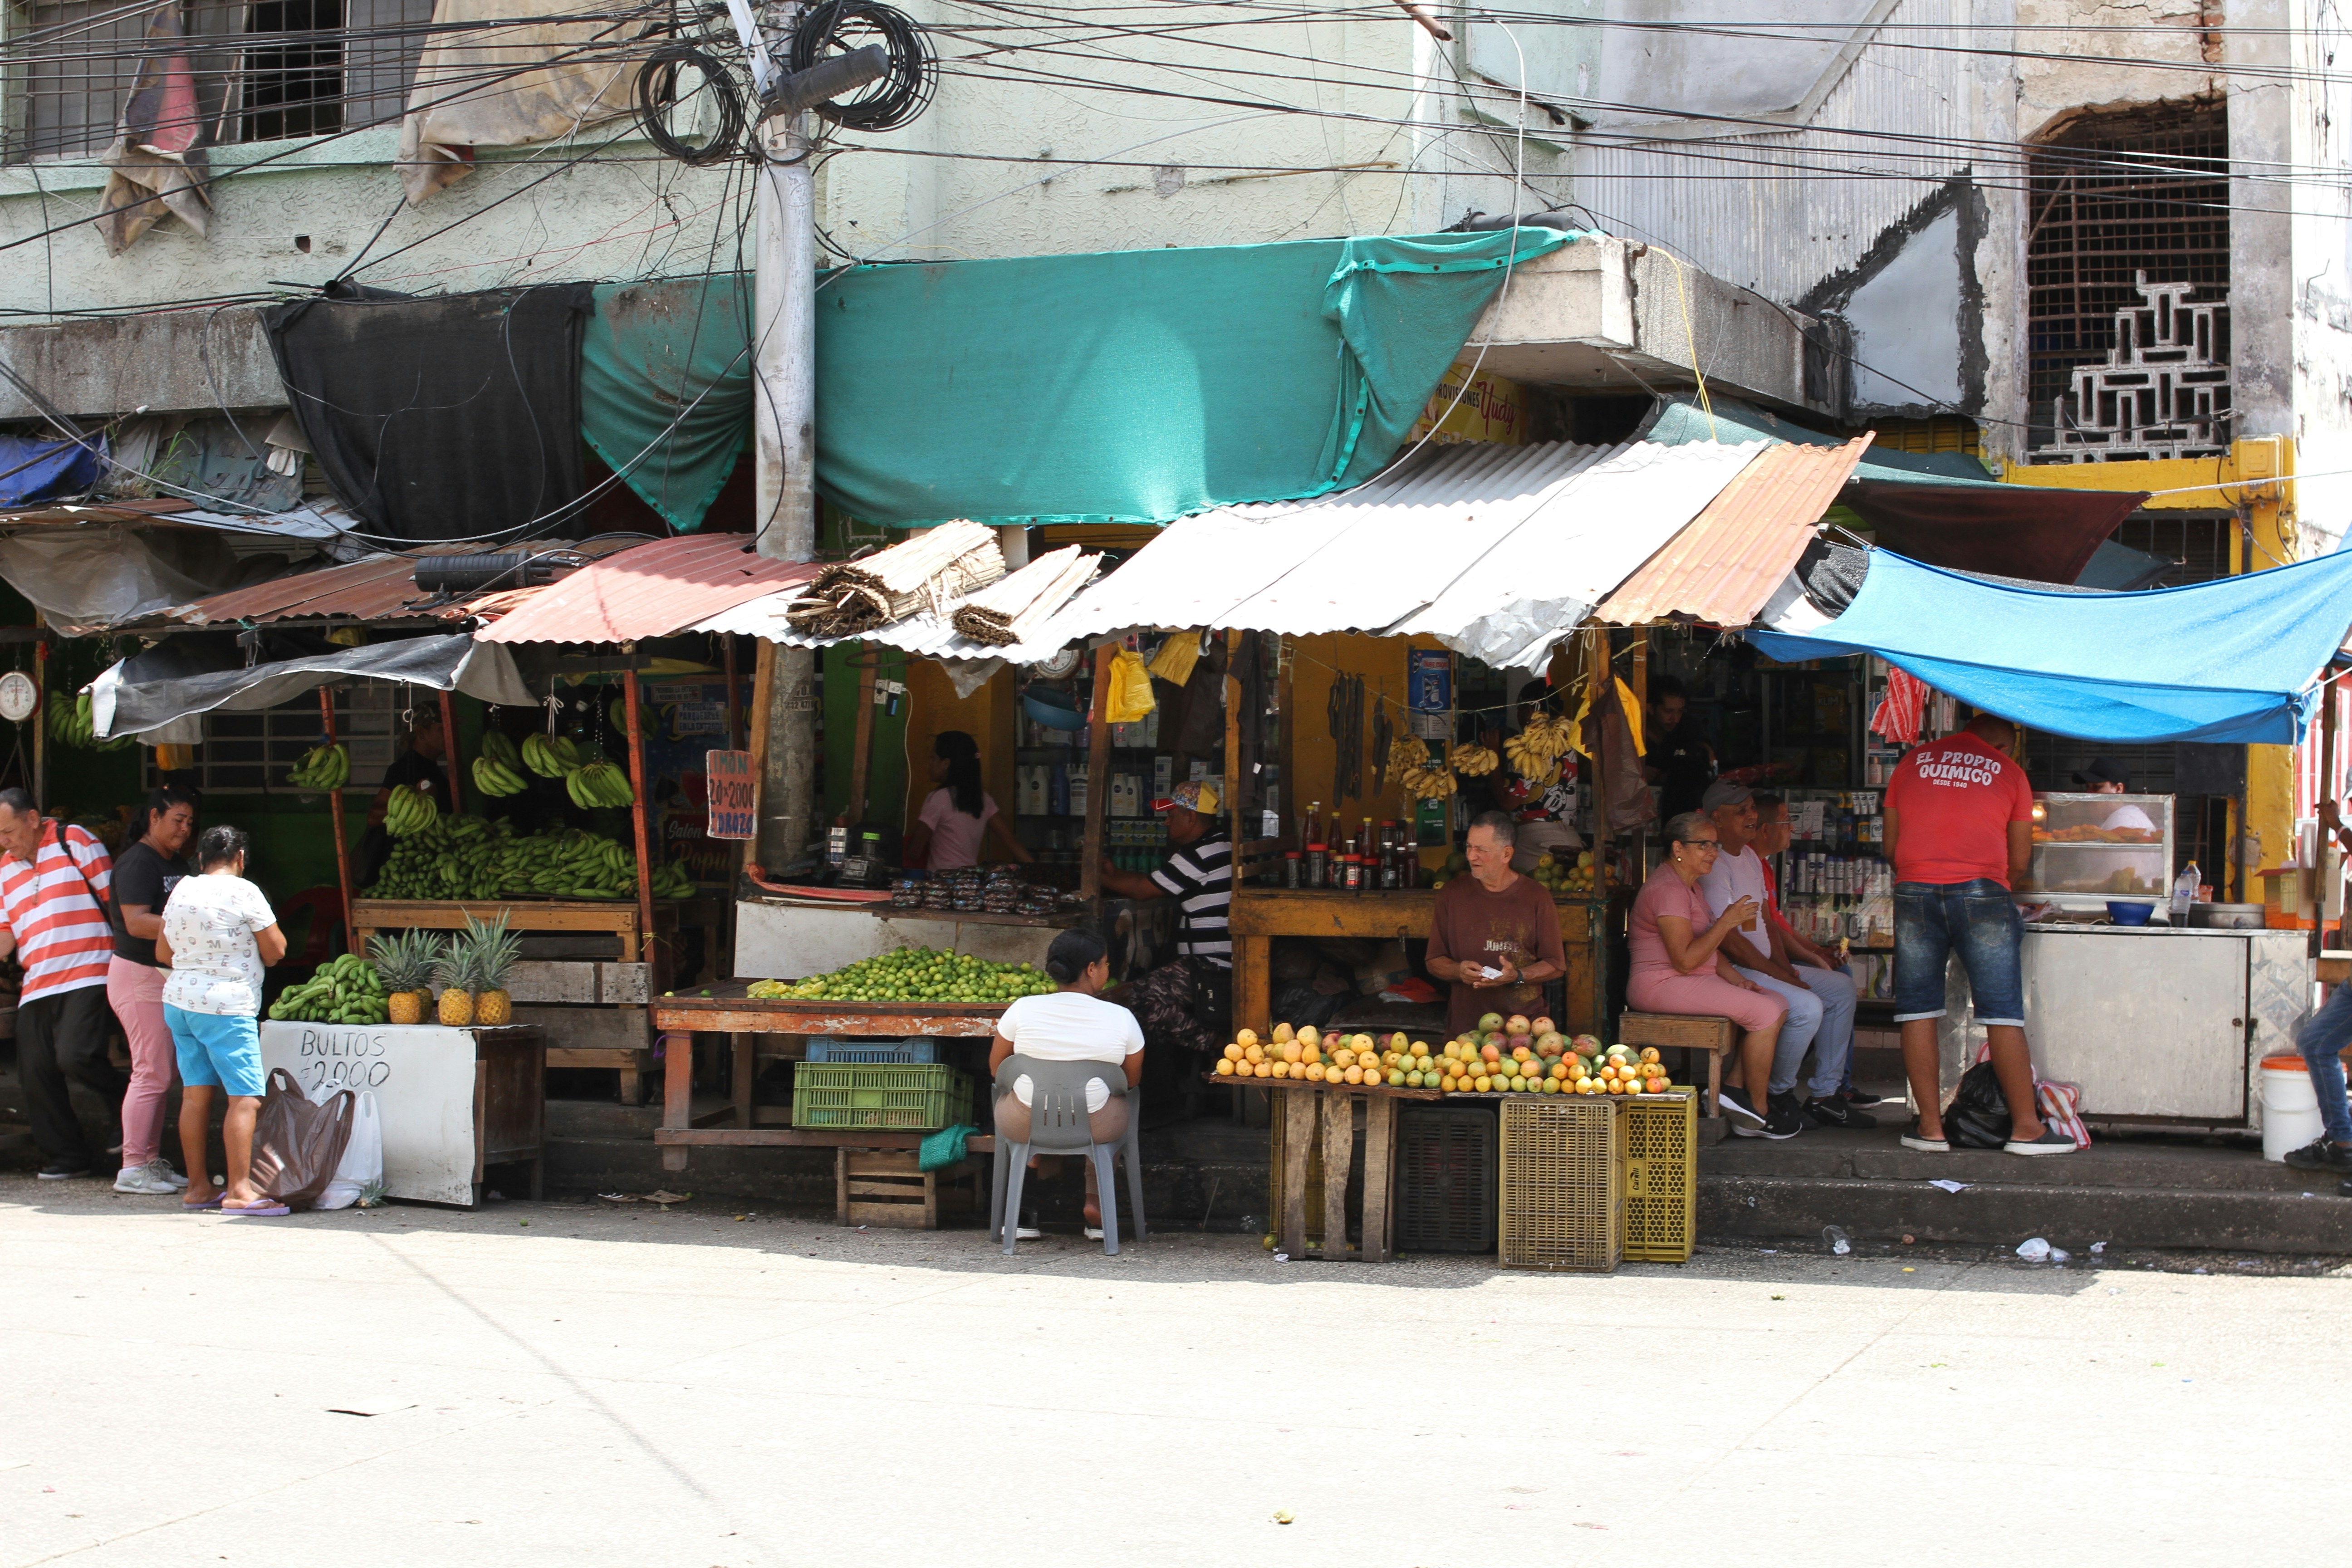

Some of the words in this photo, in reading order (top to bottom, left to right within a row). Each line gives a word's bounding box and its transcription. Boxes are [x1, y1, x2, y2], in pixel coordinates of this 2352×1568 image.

[1476, 380, 1516, 436] Yudy
[1916, 751, 1934, 765] EL
[1940, 751, 2001, 774] PROPIO
[1919, 764, 1992, 786] QUIMICO
[667, 820, 702, 839] Salón
[670, 839, 730, 880] Popu
[301, 1029, 387, 1056] BULTOS
